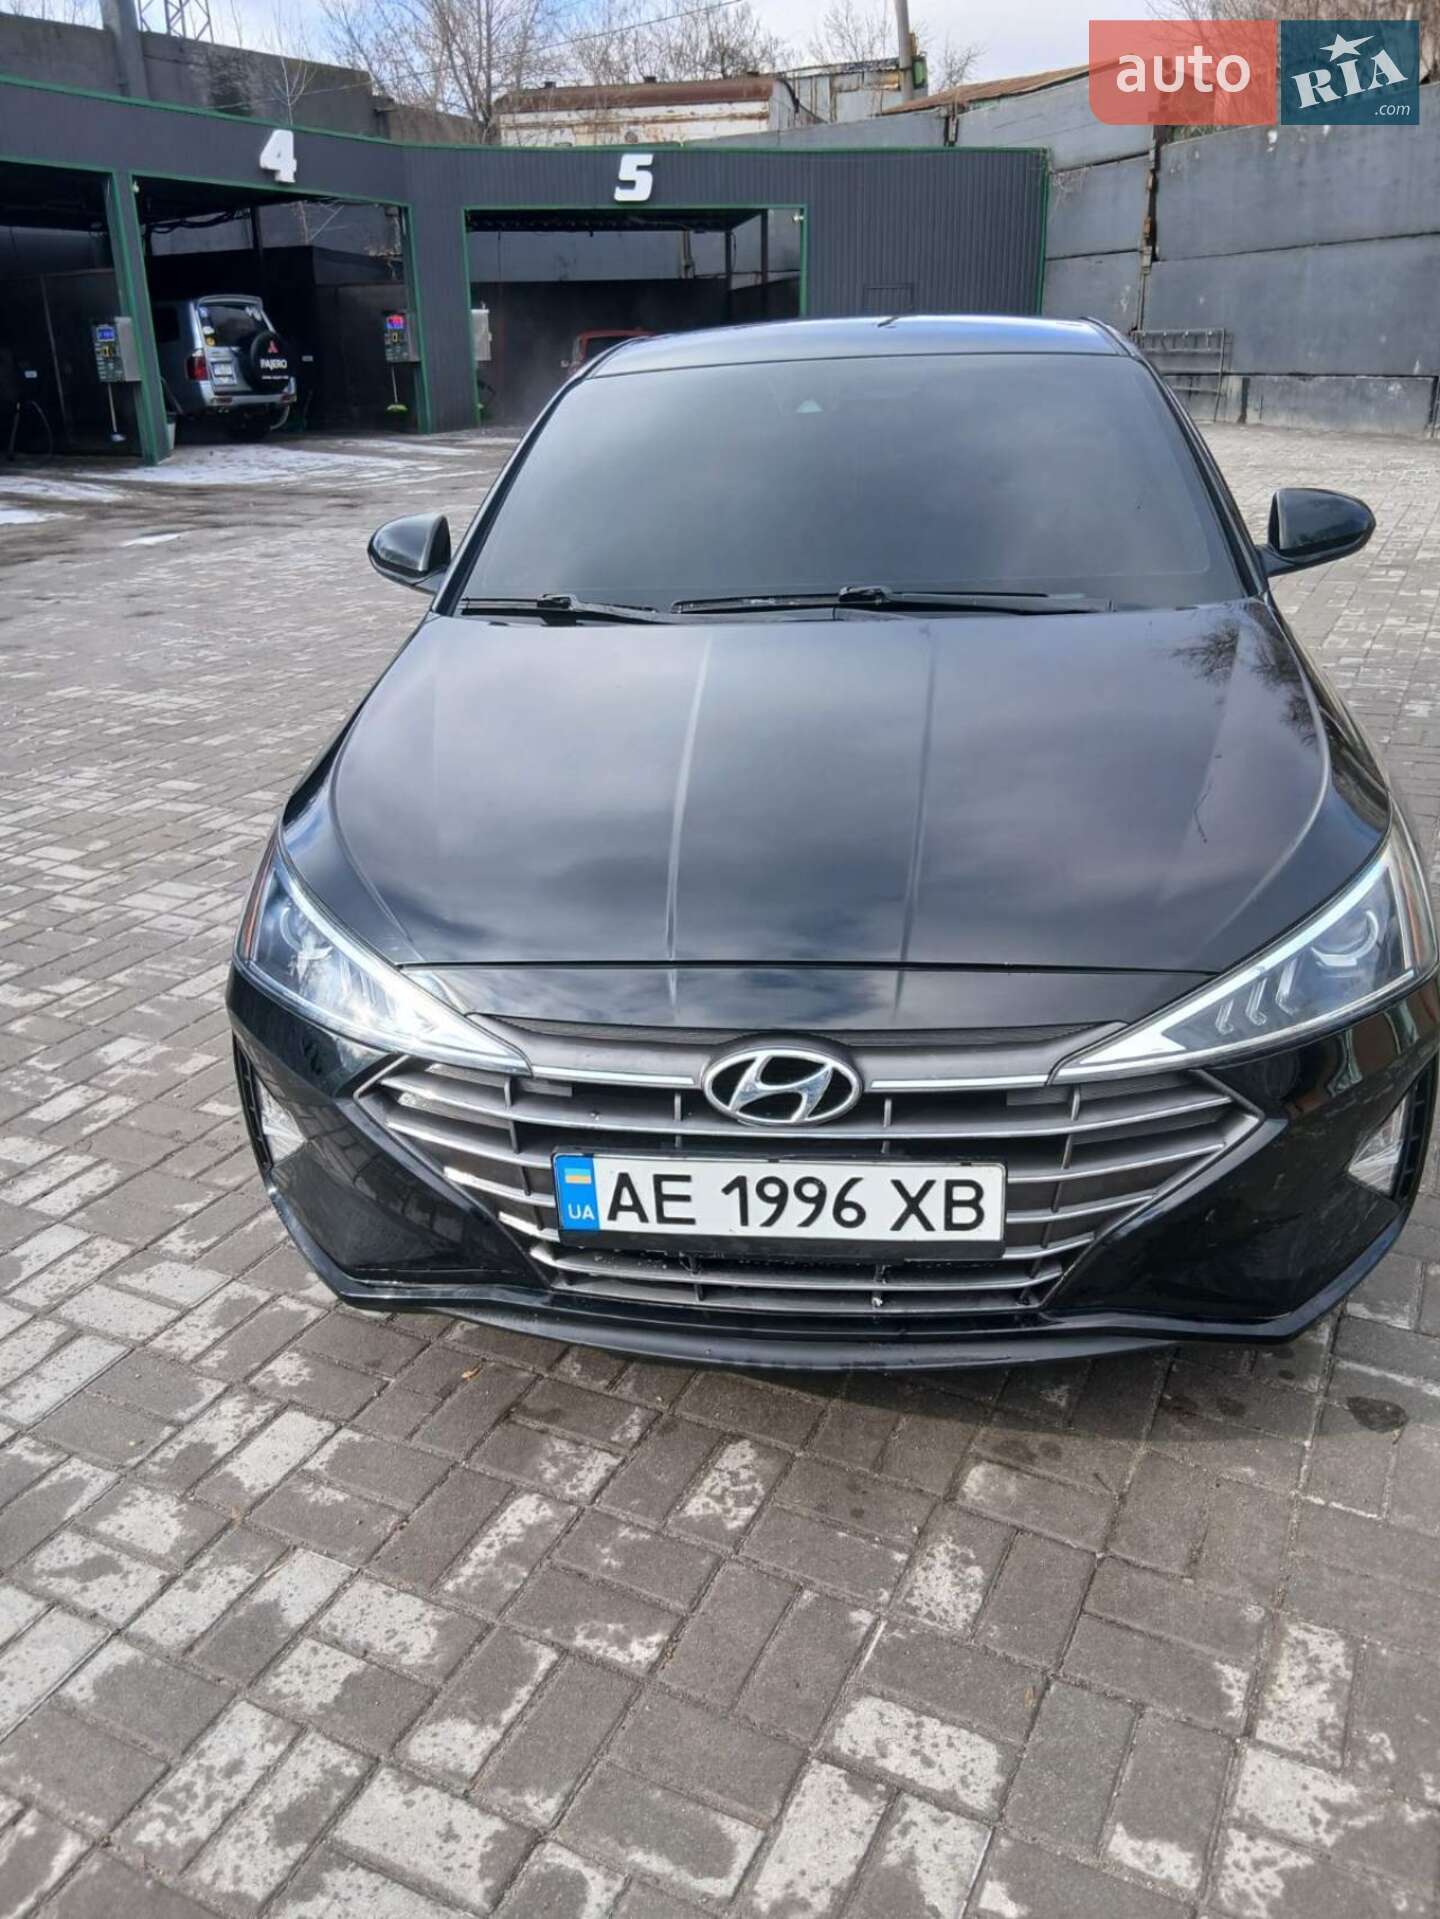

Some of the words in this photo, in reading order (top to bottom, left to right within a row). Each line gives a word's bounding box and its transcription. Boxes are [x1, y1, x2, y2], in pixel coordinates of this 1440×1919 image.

[259, 129, 297, 184] 4
[613, 153, 654, 202] 5
[260, 358, 288, 371] PAJERO
[568, 1203, 595, 1221] UA
[606, 1172, 697, 1225] AE
[721, 1175, 867, 1229] 1996
[889, 1178, 986, 1232] XB
